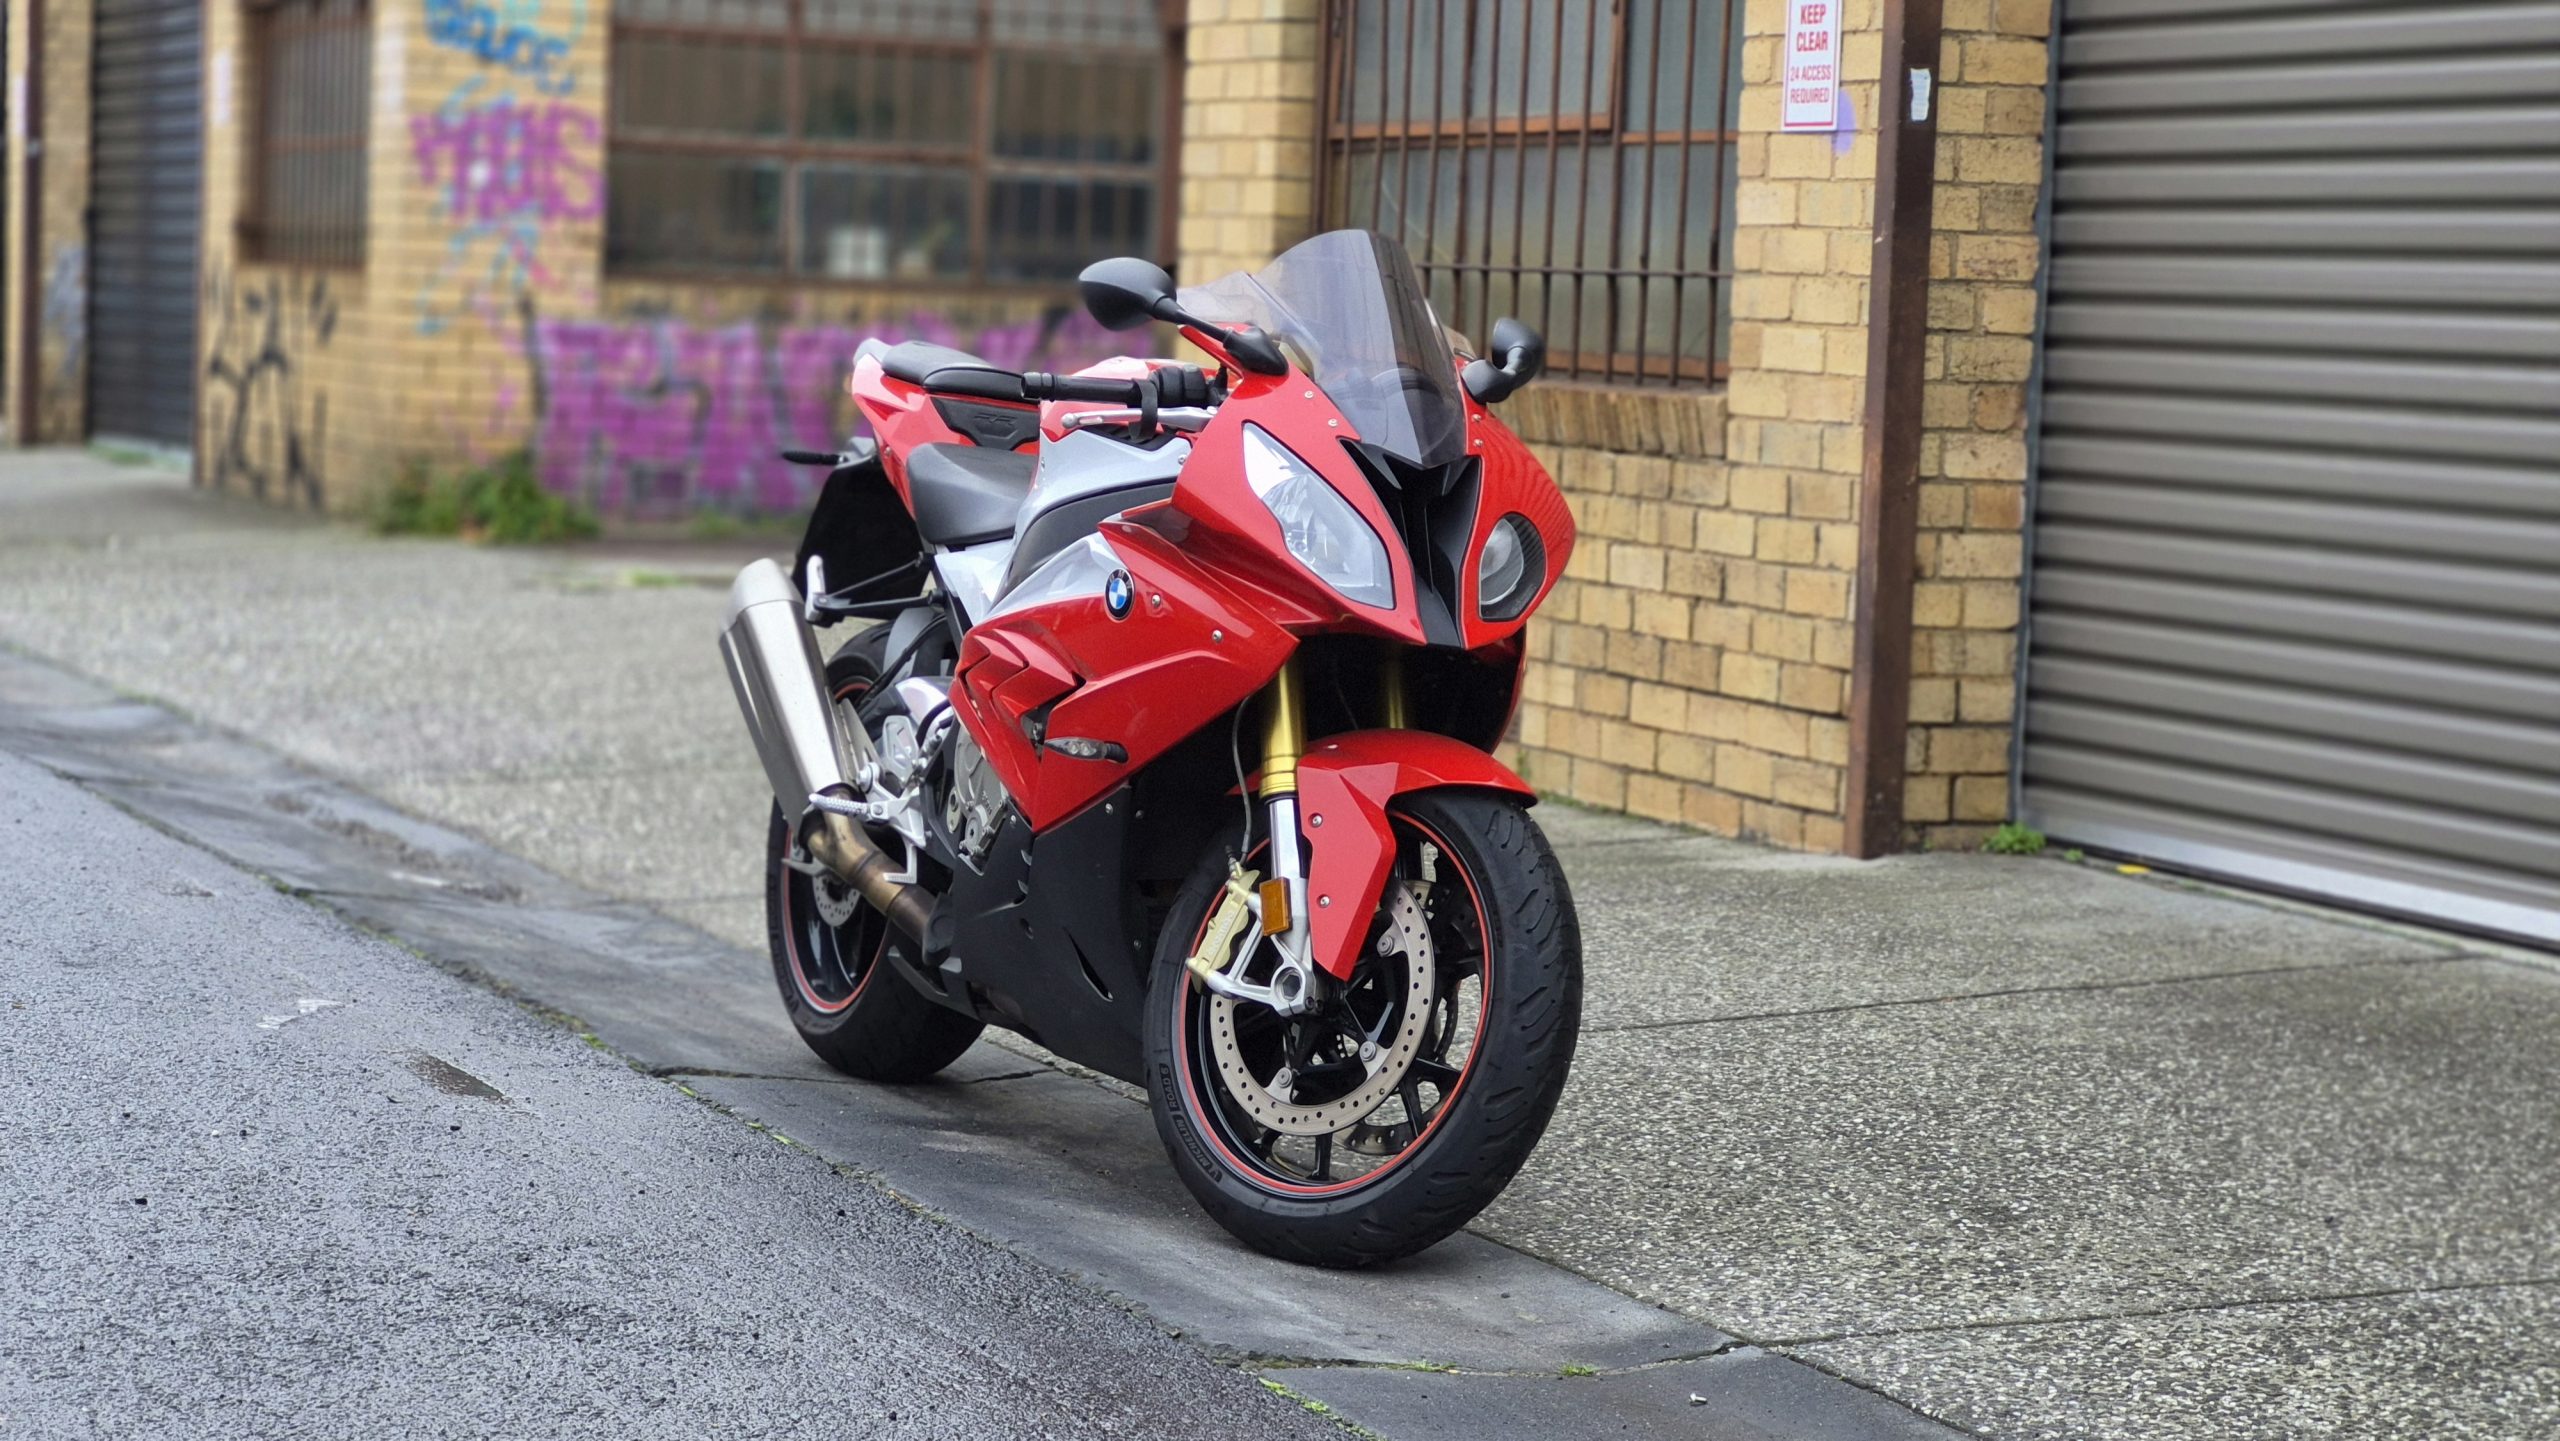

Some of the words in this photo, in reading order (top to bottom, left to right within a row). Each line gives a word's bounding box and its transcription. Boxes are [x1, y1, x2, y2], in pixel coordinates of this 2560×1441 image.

[1801, 4, 1826, 24] KEEP
[1797, 31, 1828, 51] CLEAR
[1790, 66, 1799, 81] 24
[1801, 65, 1831, 80] ACCESS
[1790, 88, 1829, 103] REQUIRED
[1163, 1078, 1178, 1107] ROAD
[1176, 1117, 1211, 1169] MICHELIN
